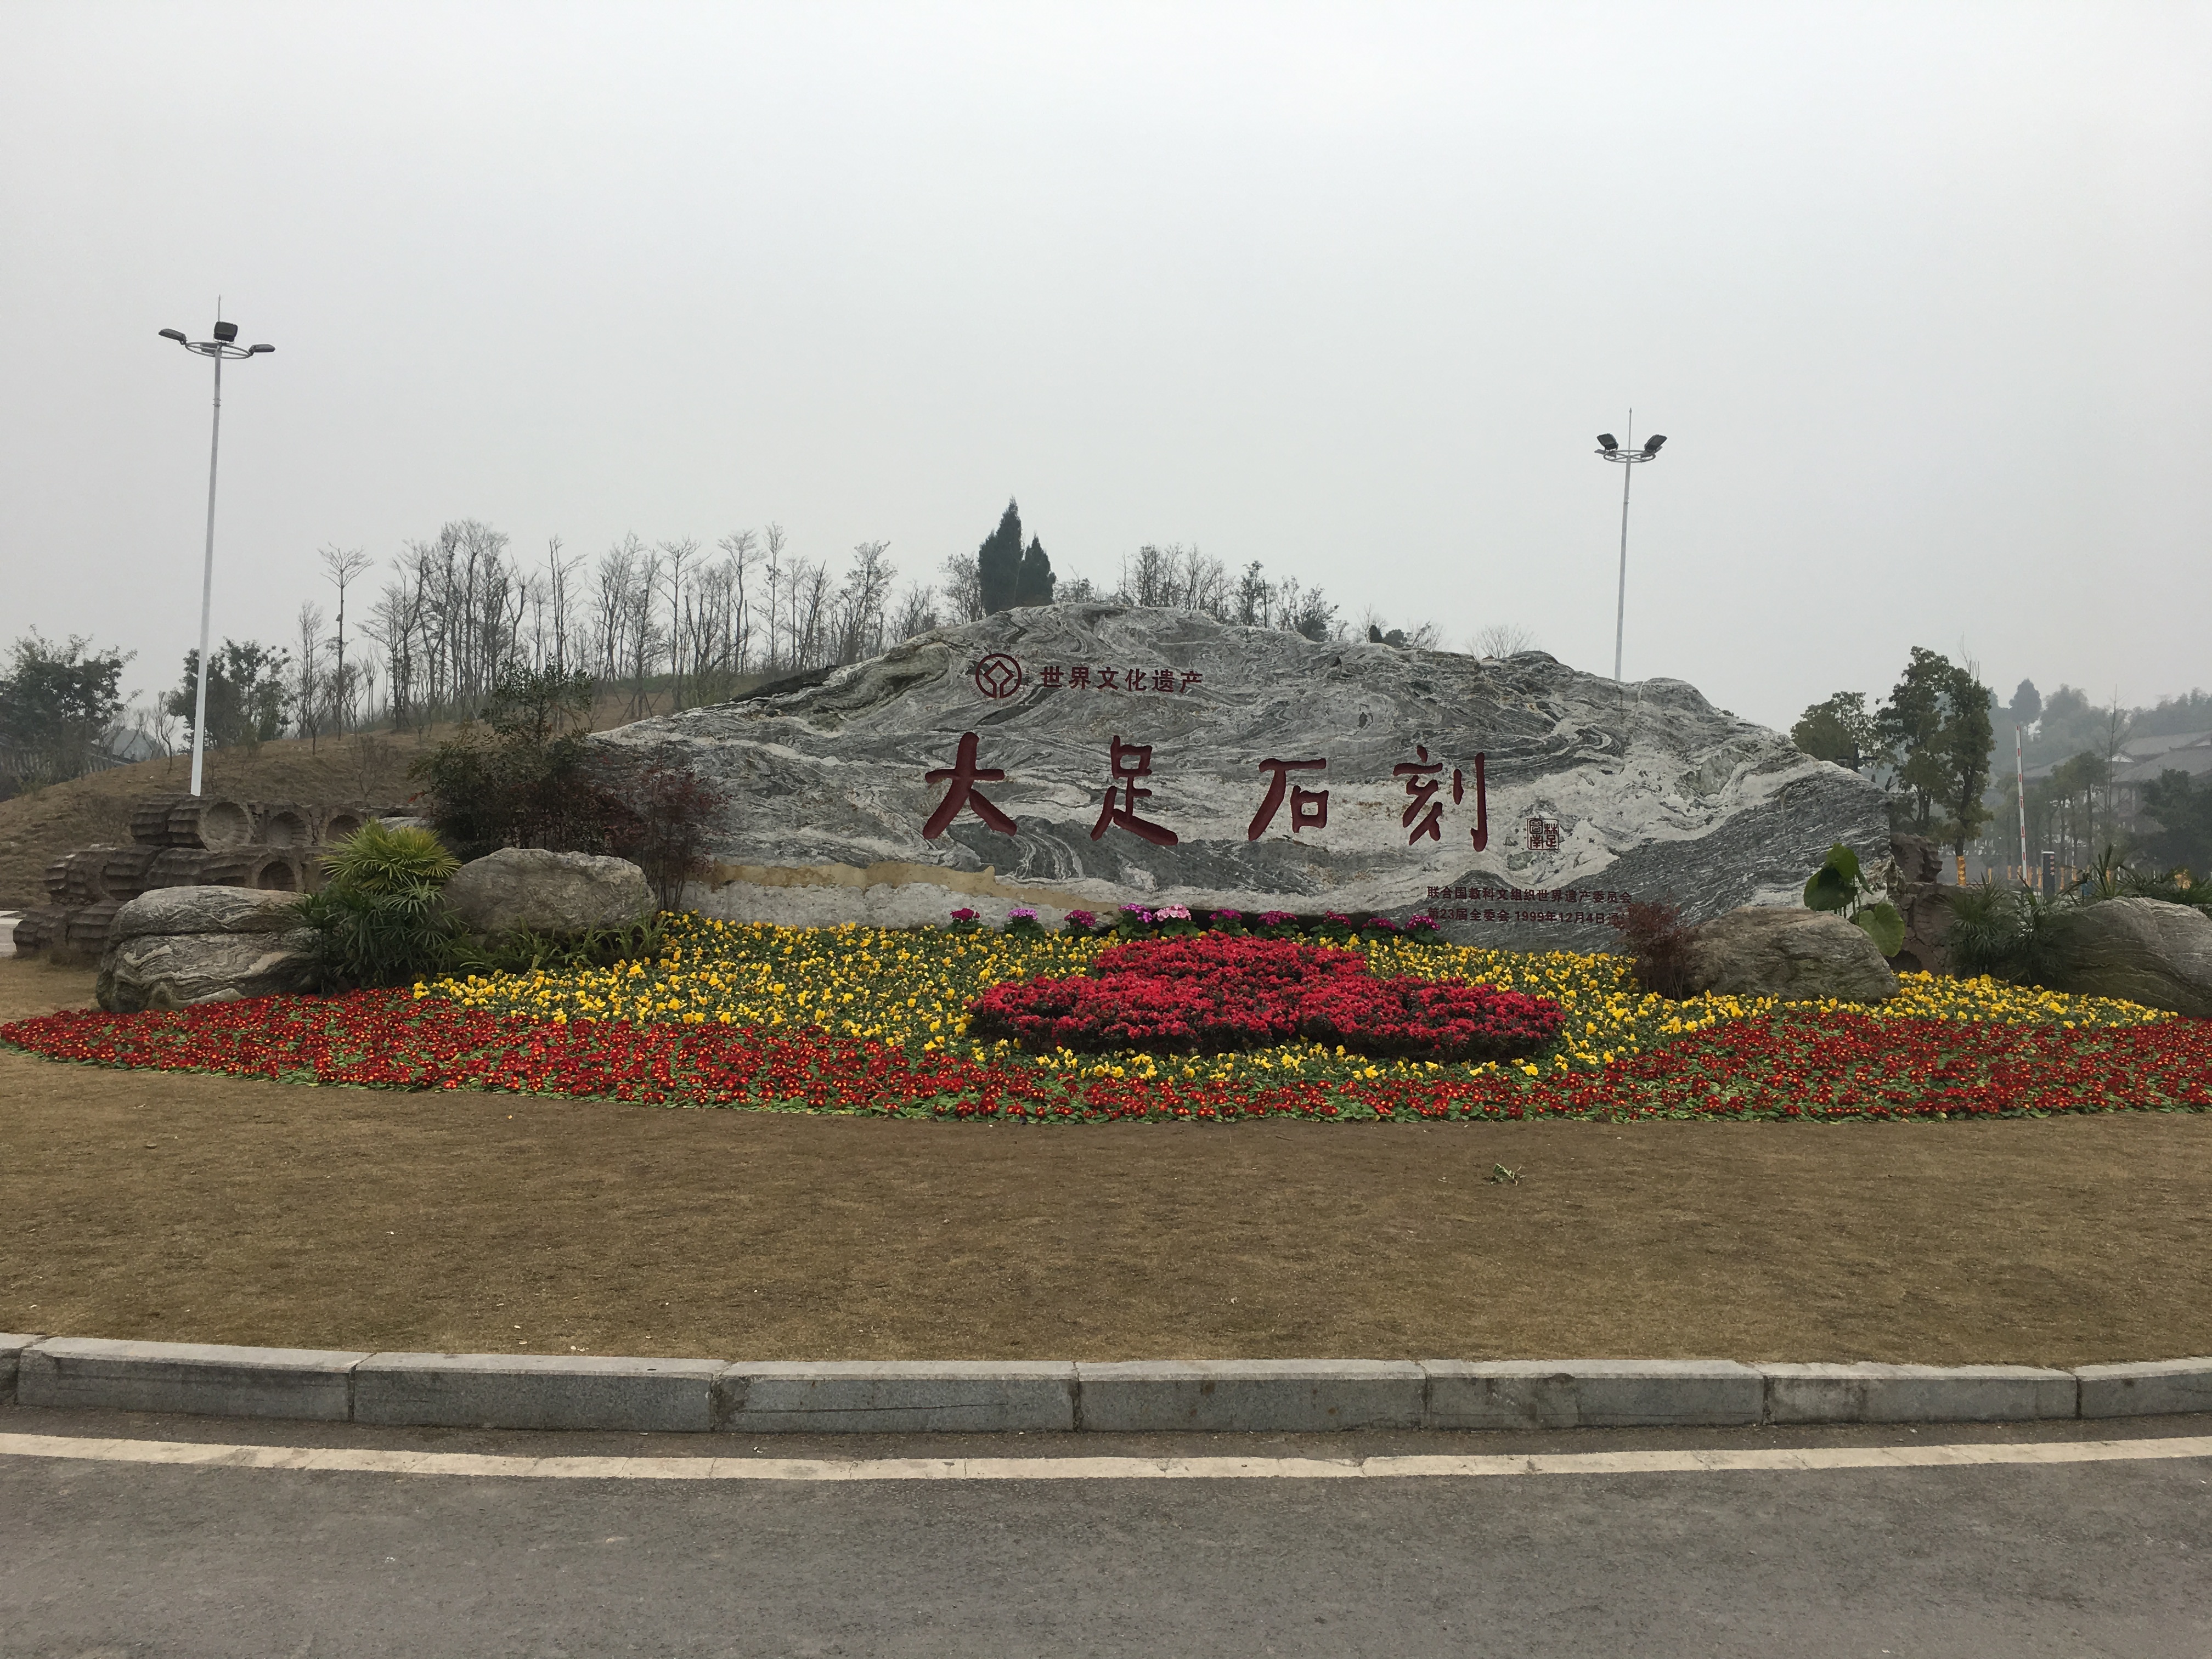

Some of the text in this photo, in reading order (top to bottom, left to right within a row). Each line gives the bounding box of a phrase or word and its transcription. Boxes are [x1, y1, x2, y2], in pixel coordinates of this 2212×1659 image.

[1040, 665, 1203, 693] 世界文化遗产
[922, 731, 1488, 852] 大足石刻
[1427, 886, 1632, 904] 联合国教科文组织世界遗产委员会
[1427, 907, 1510, 922] 第23届全委会
